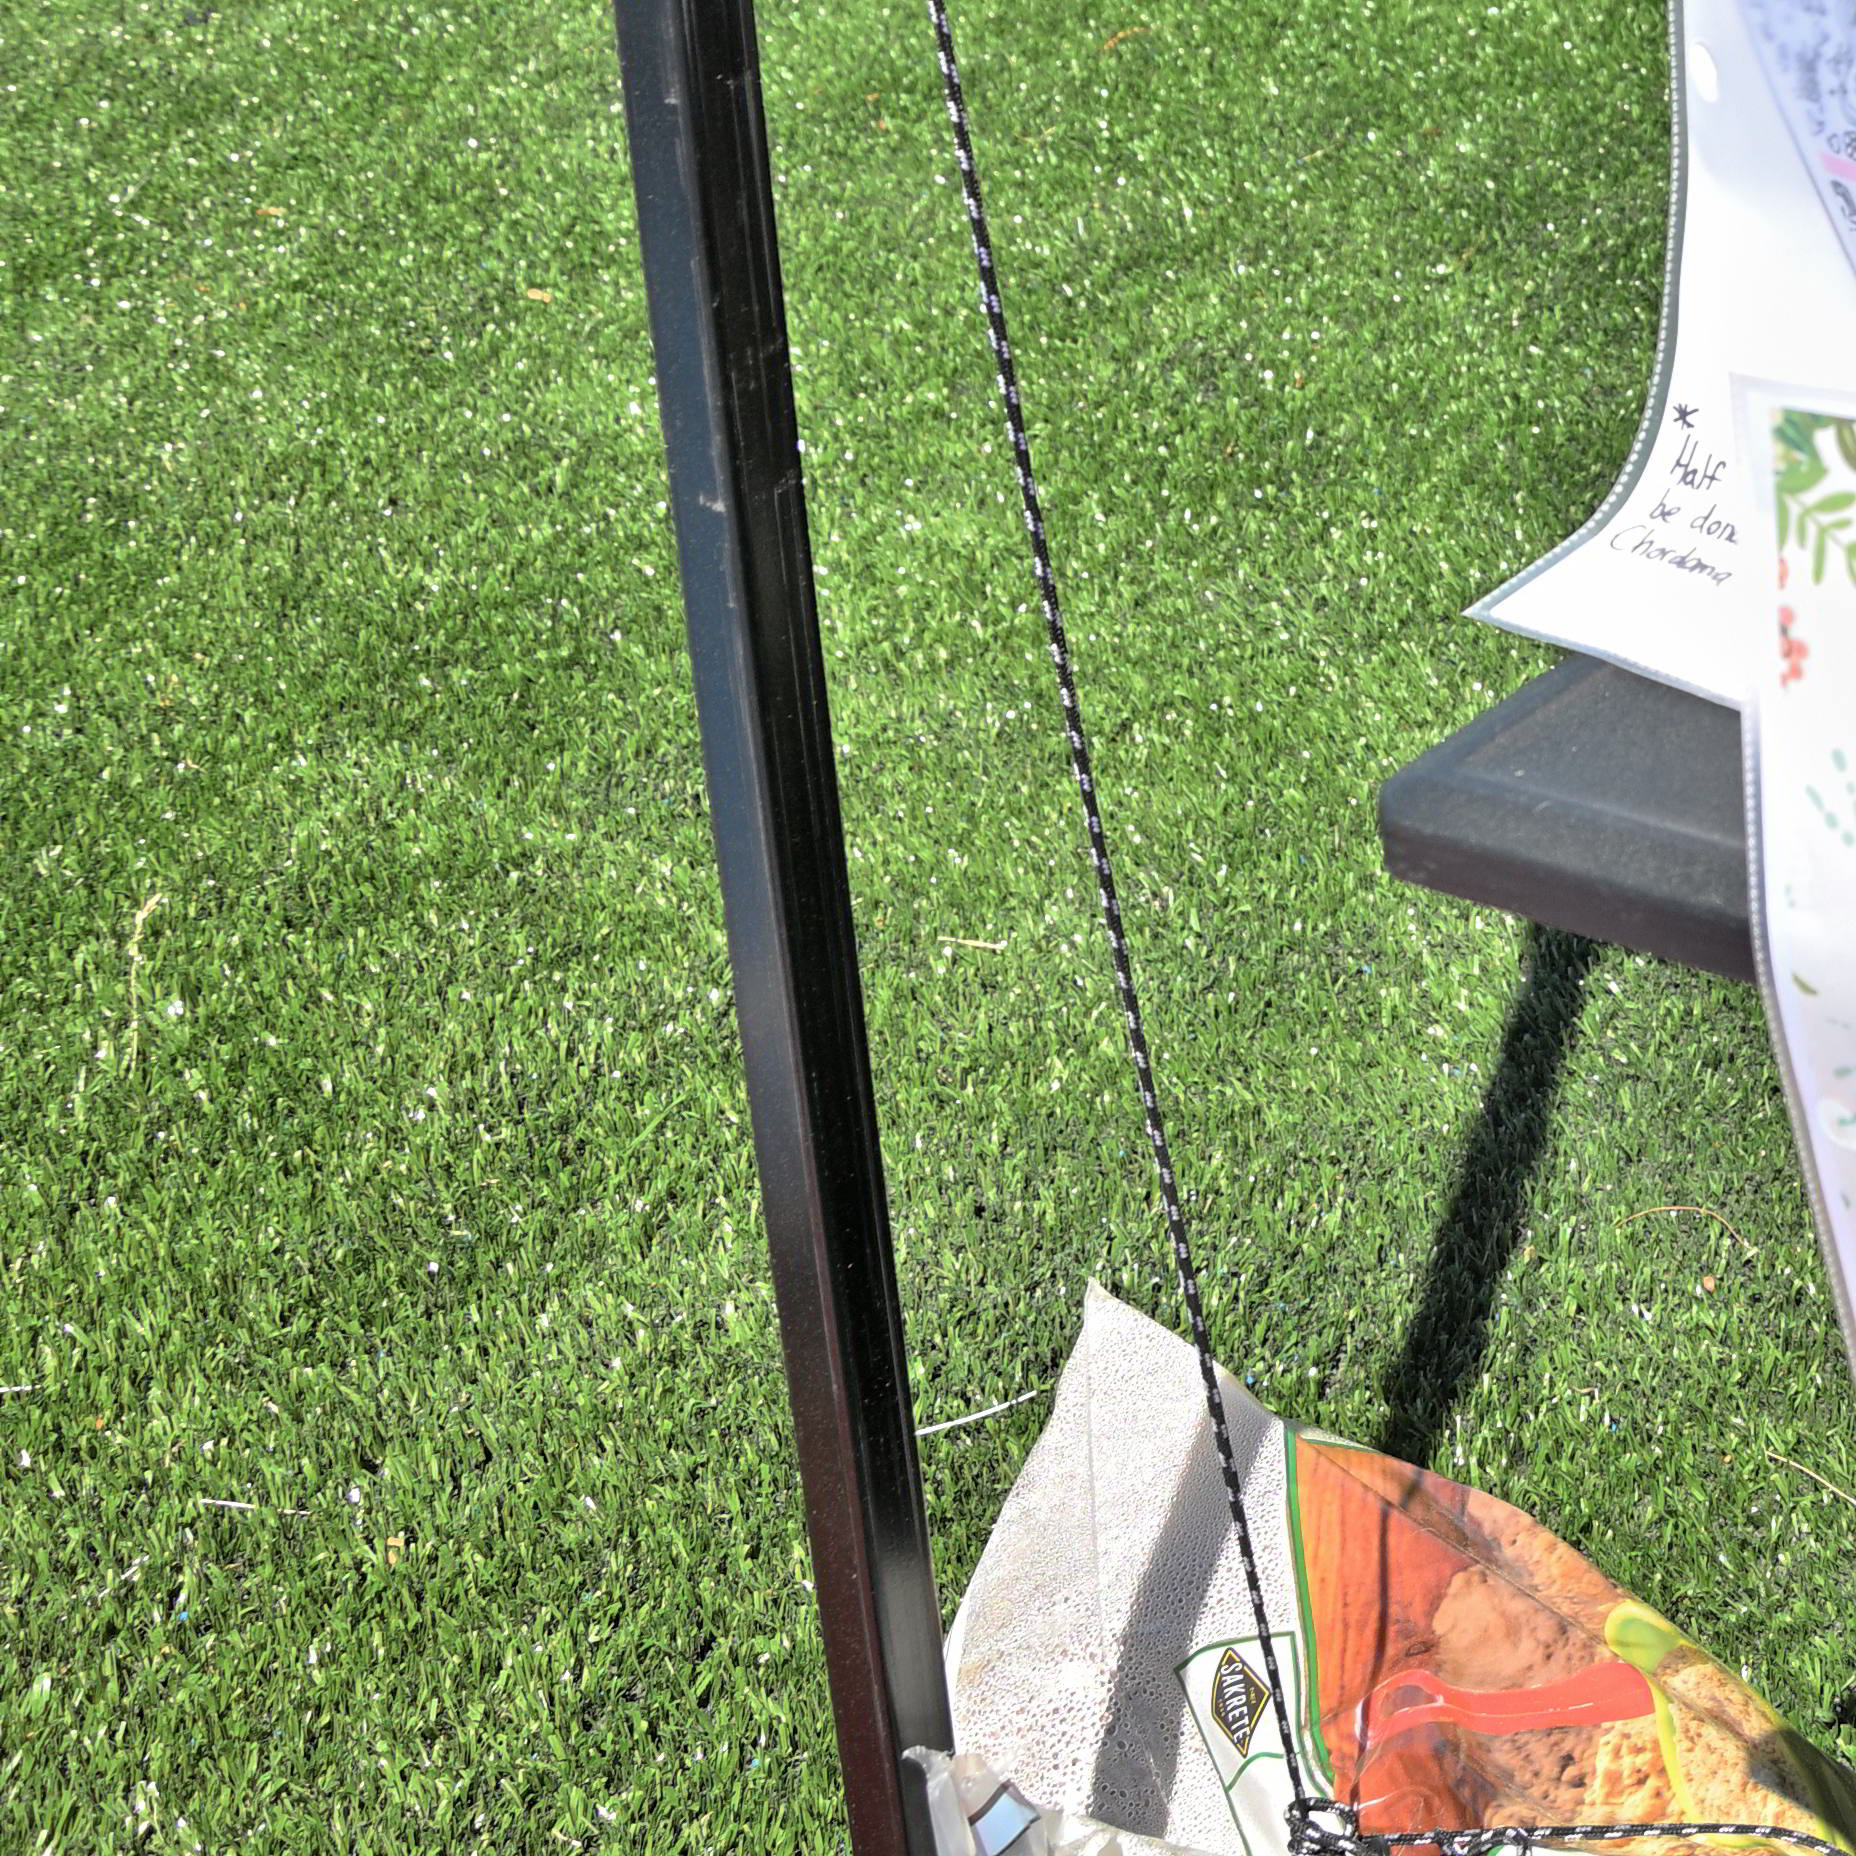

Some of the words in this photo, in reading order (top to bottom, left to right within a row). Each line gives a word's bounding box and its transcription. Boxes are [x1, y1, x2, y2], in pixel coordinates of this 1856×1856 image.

[1669, 433, 1727, 490] Half
[1649, 487, 1682, 523] be
[1220, 1661, 1251, 1744] SAKRETE
